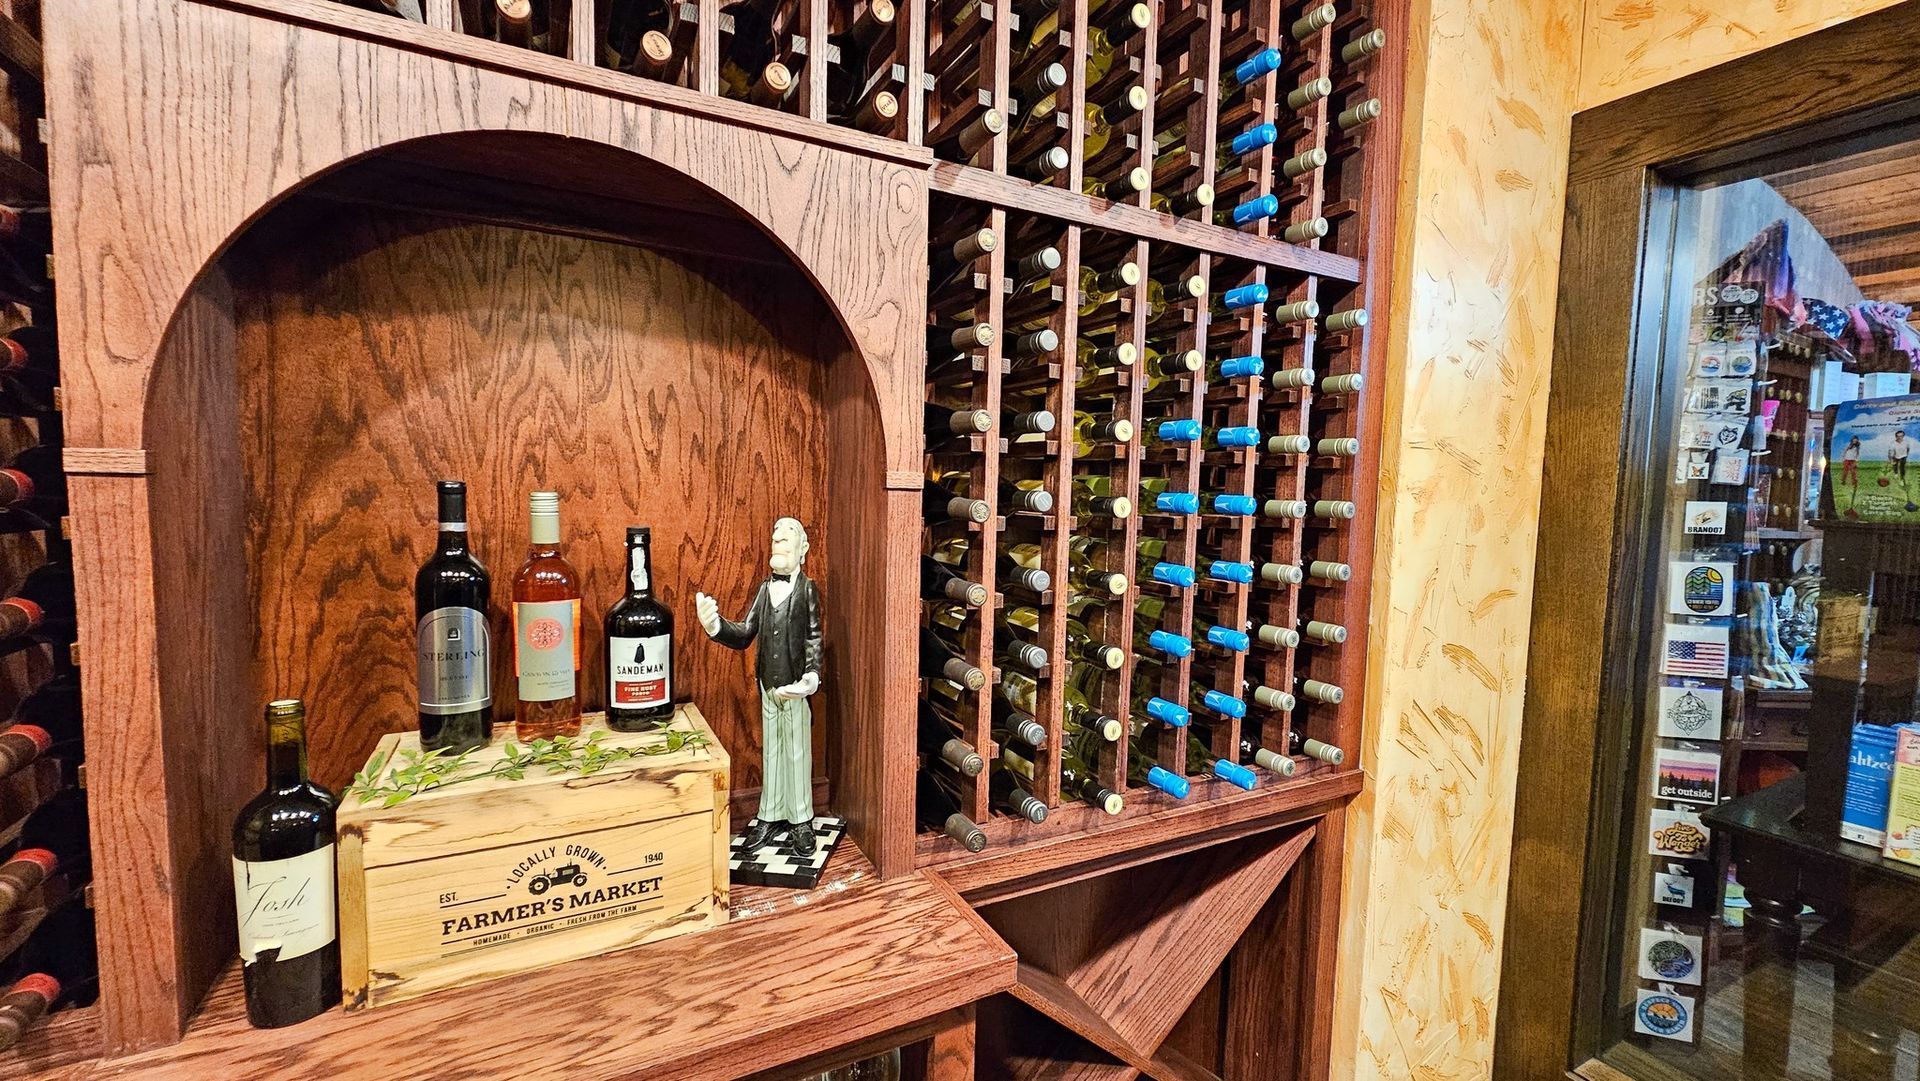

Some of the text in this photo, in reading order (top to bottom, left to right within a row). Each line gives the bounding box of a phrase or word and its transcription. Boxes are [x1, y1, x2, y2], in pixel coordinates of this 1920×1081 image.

[423, 649, 485, 661] STERLING
[617, 663, 664, 675] SANDEMAN
[1661, 786, 1713, 799] get outside
[506, 844, 606, 884] LOCALLY GROWN
[644, 852, 663, 864] 1940
[240, 876, 310, 928] Josh
[440, 892, 458, 903] EST.
[442, 876, 663, 936] FARMER'S MARKET
[473, 904, 637, 946] HOMEMADE ORGANIC FRESH FROM THE FARM
